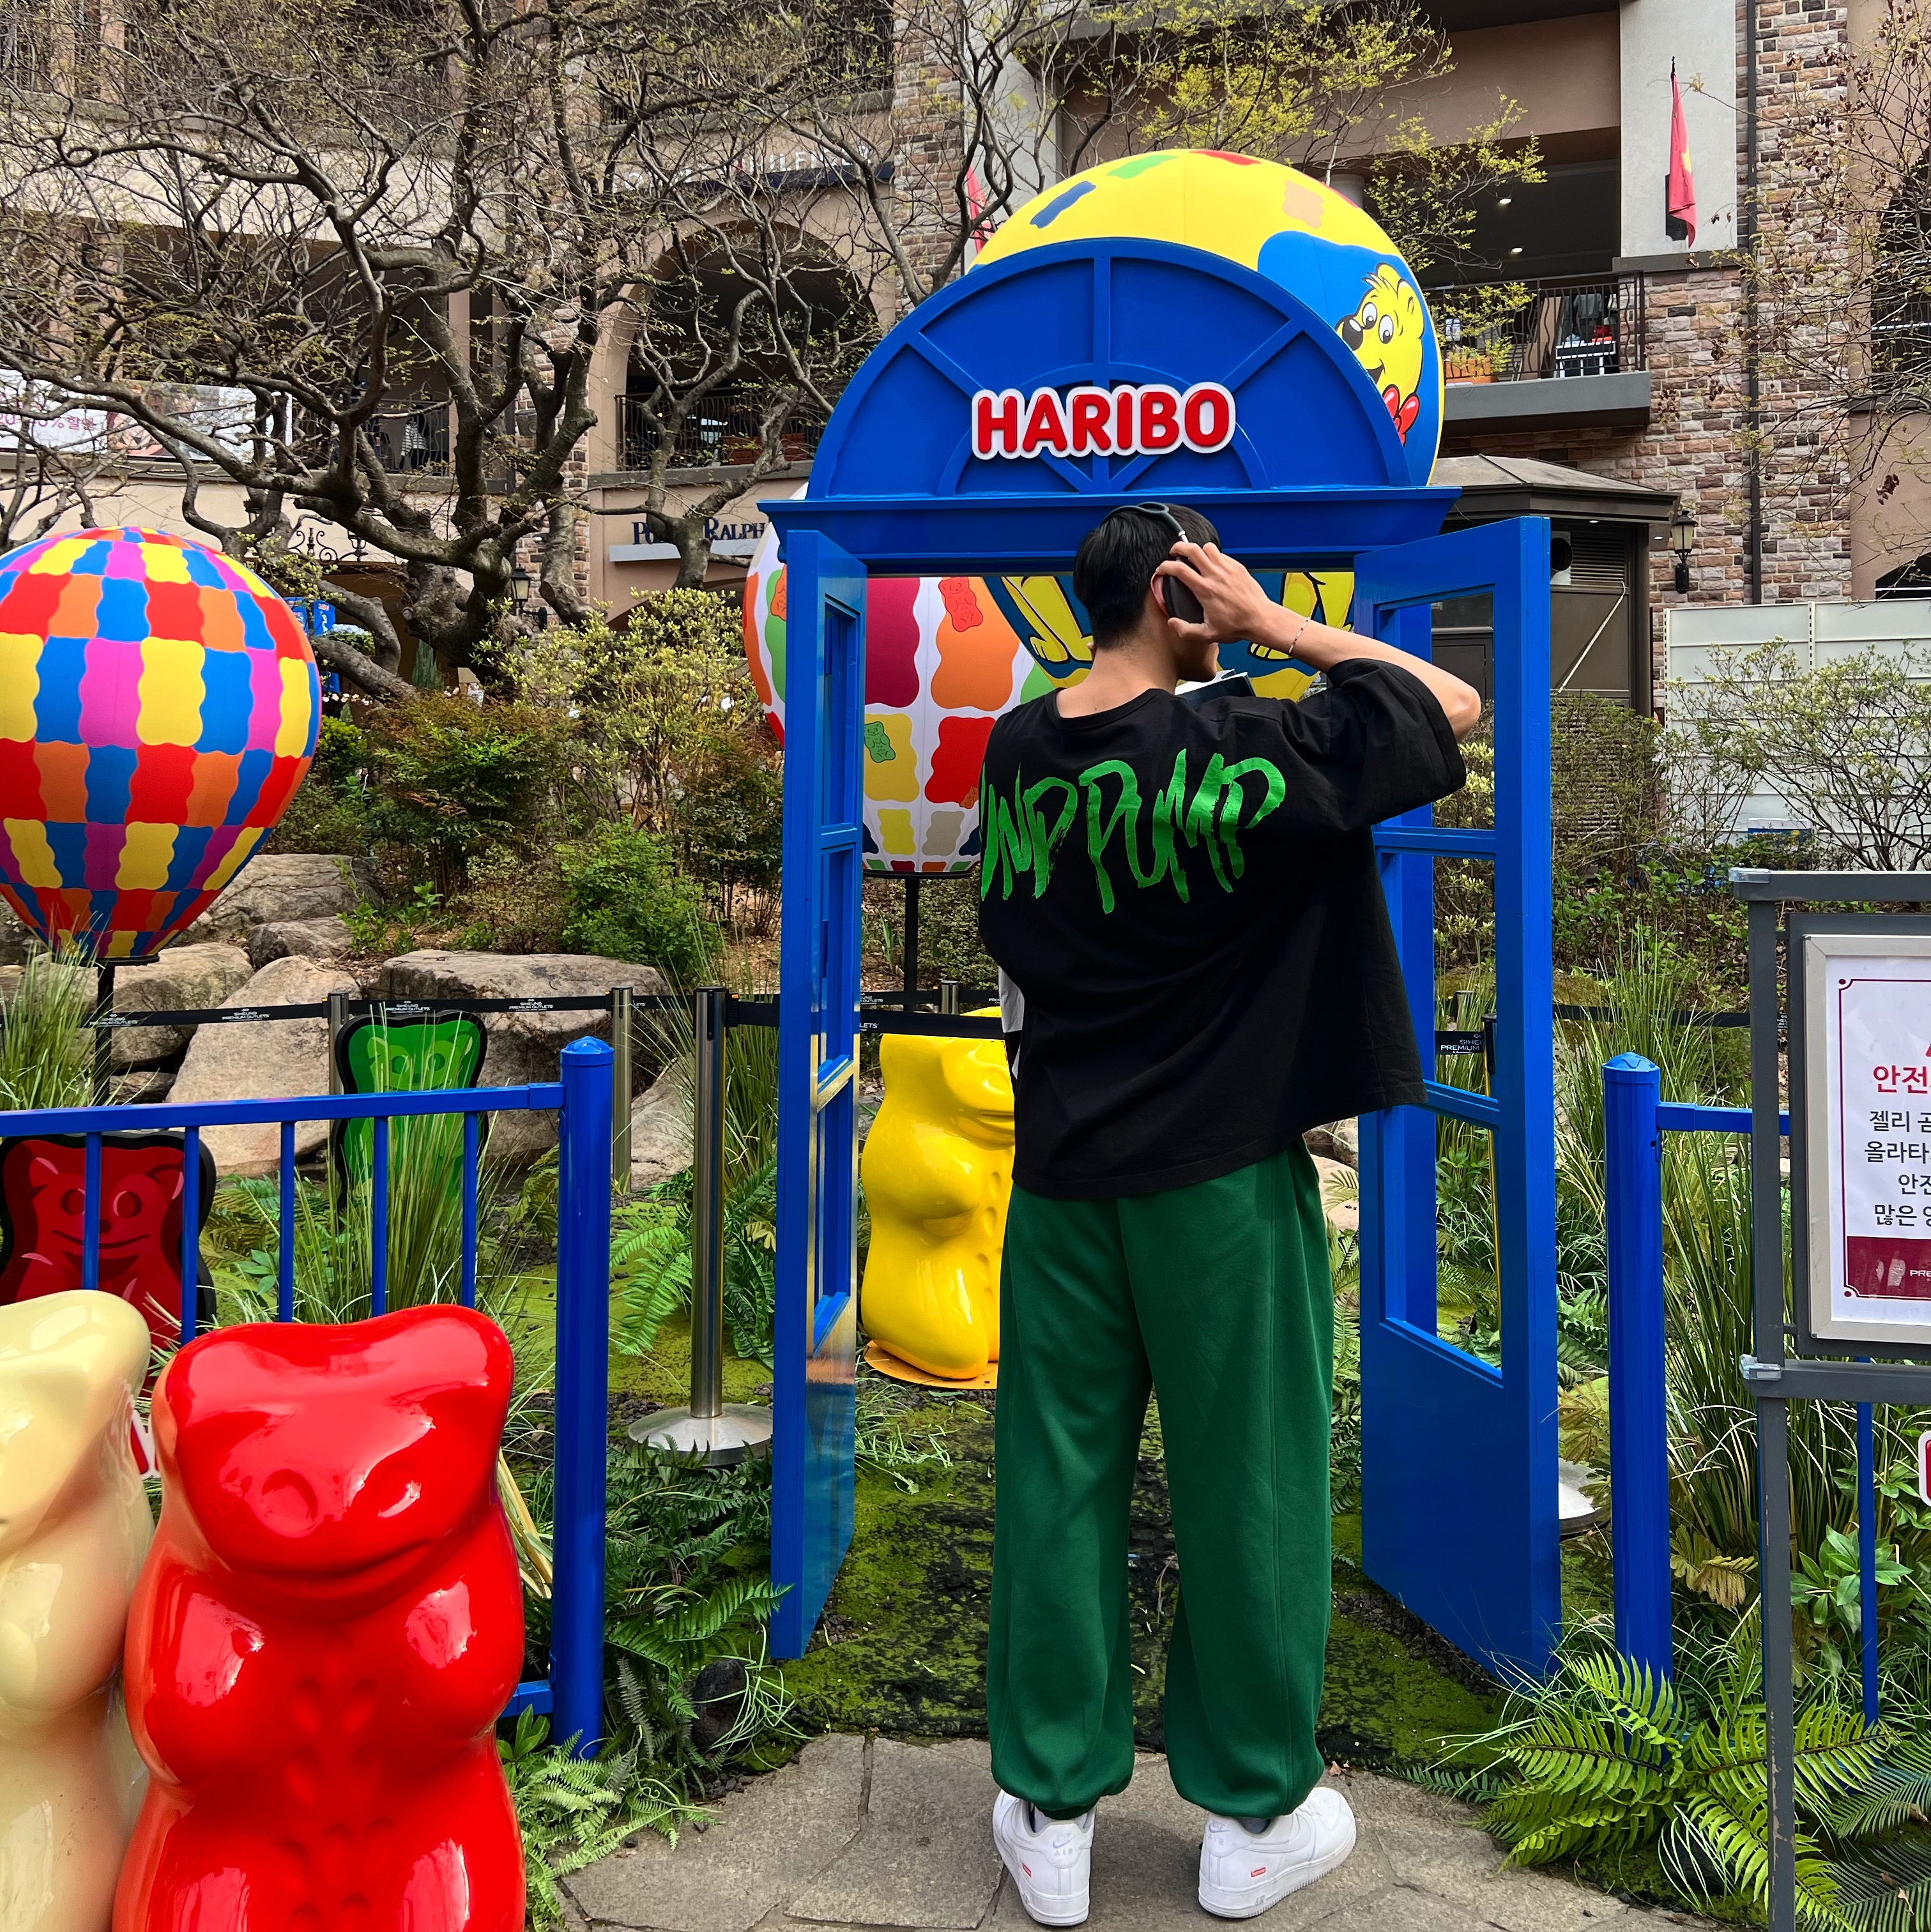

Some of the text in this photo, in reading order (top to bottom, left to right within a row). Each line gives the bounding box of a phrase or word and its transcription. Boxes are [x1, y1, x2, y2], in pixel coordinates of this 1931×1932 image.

[976, 387, 1231, 455] HARIBO
[704, 514, 765, 541] RALPH
[1078, 748, 1286, 915] PUMP
[1873, 1065, 1931, 1094] 안전
[1869, 1110, 1910, 1133] 젤리
[1864, 1141, 1931, 1164] 올라타
[1874, 1204, 1918, 1227] 많은
